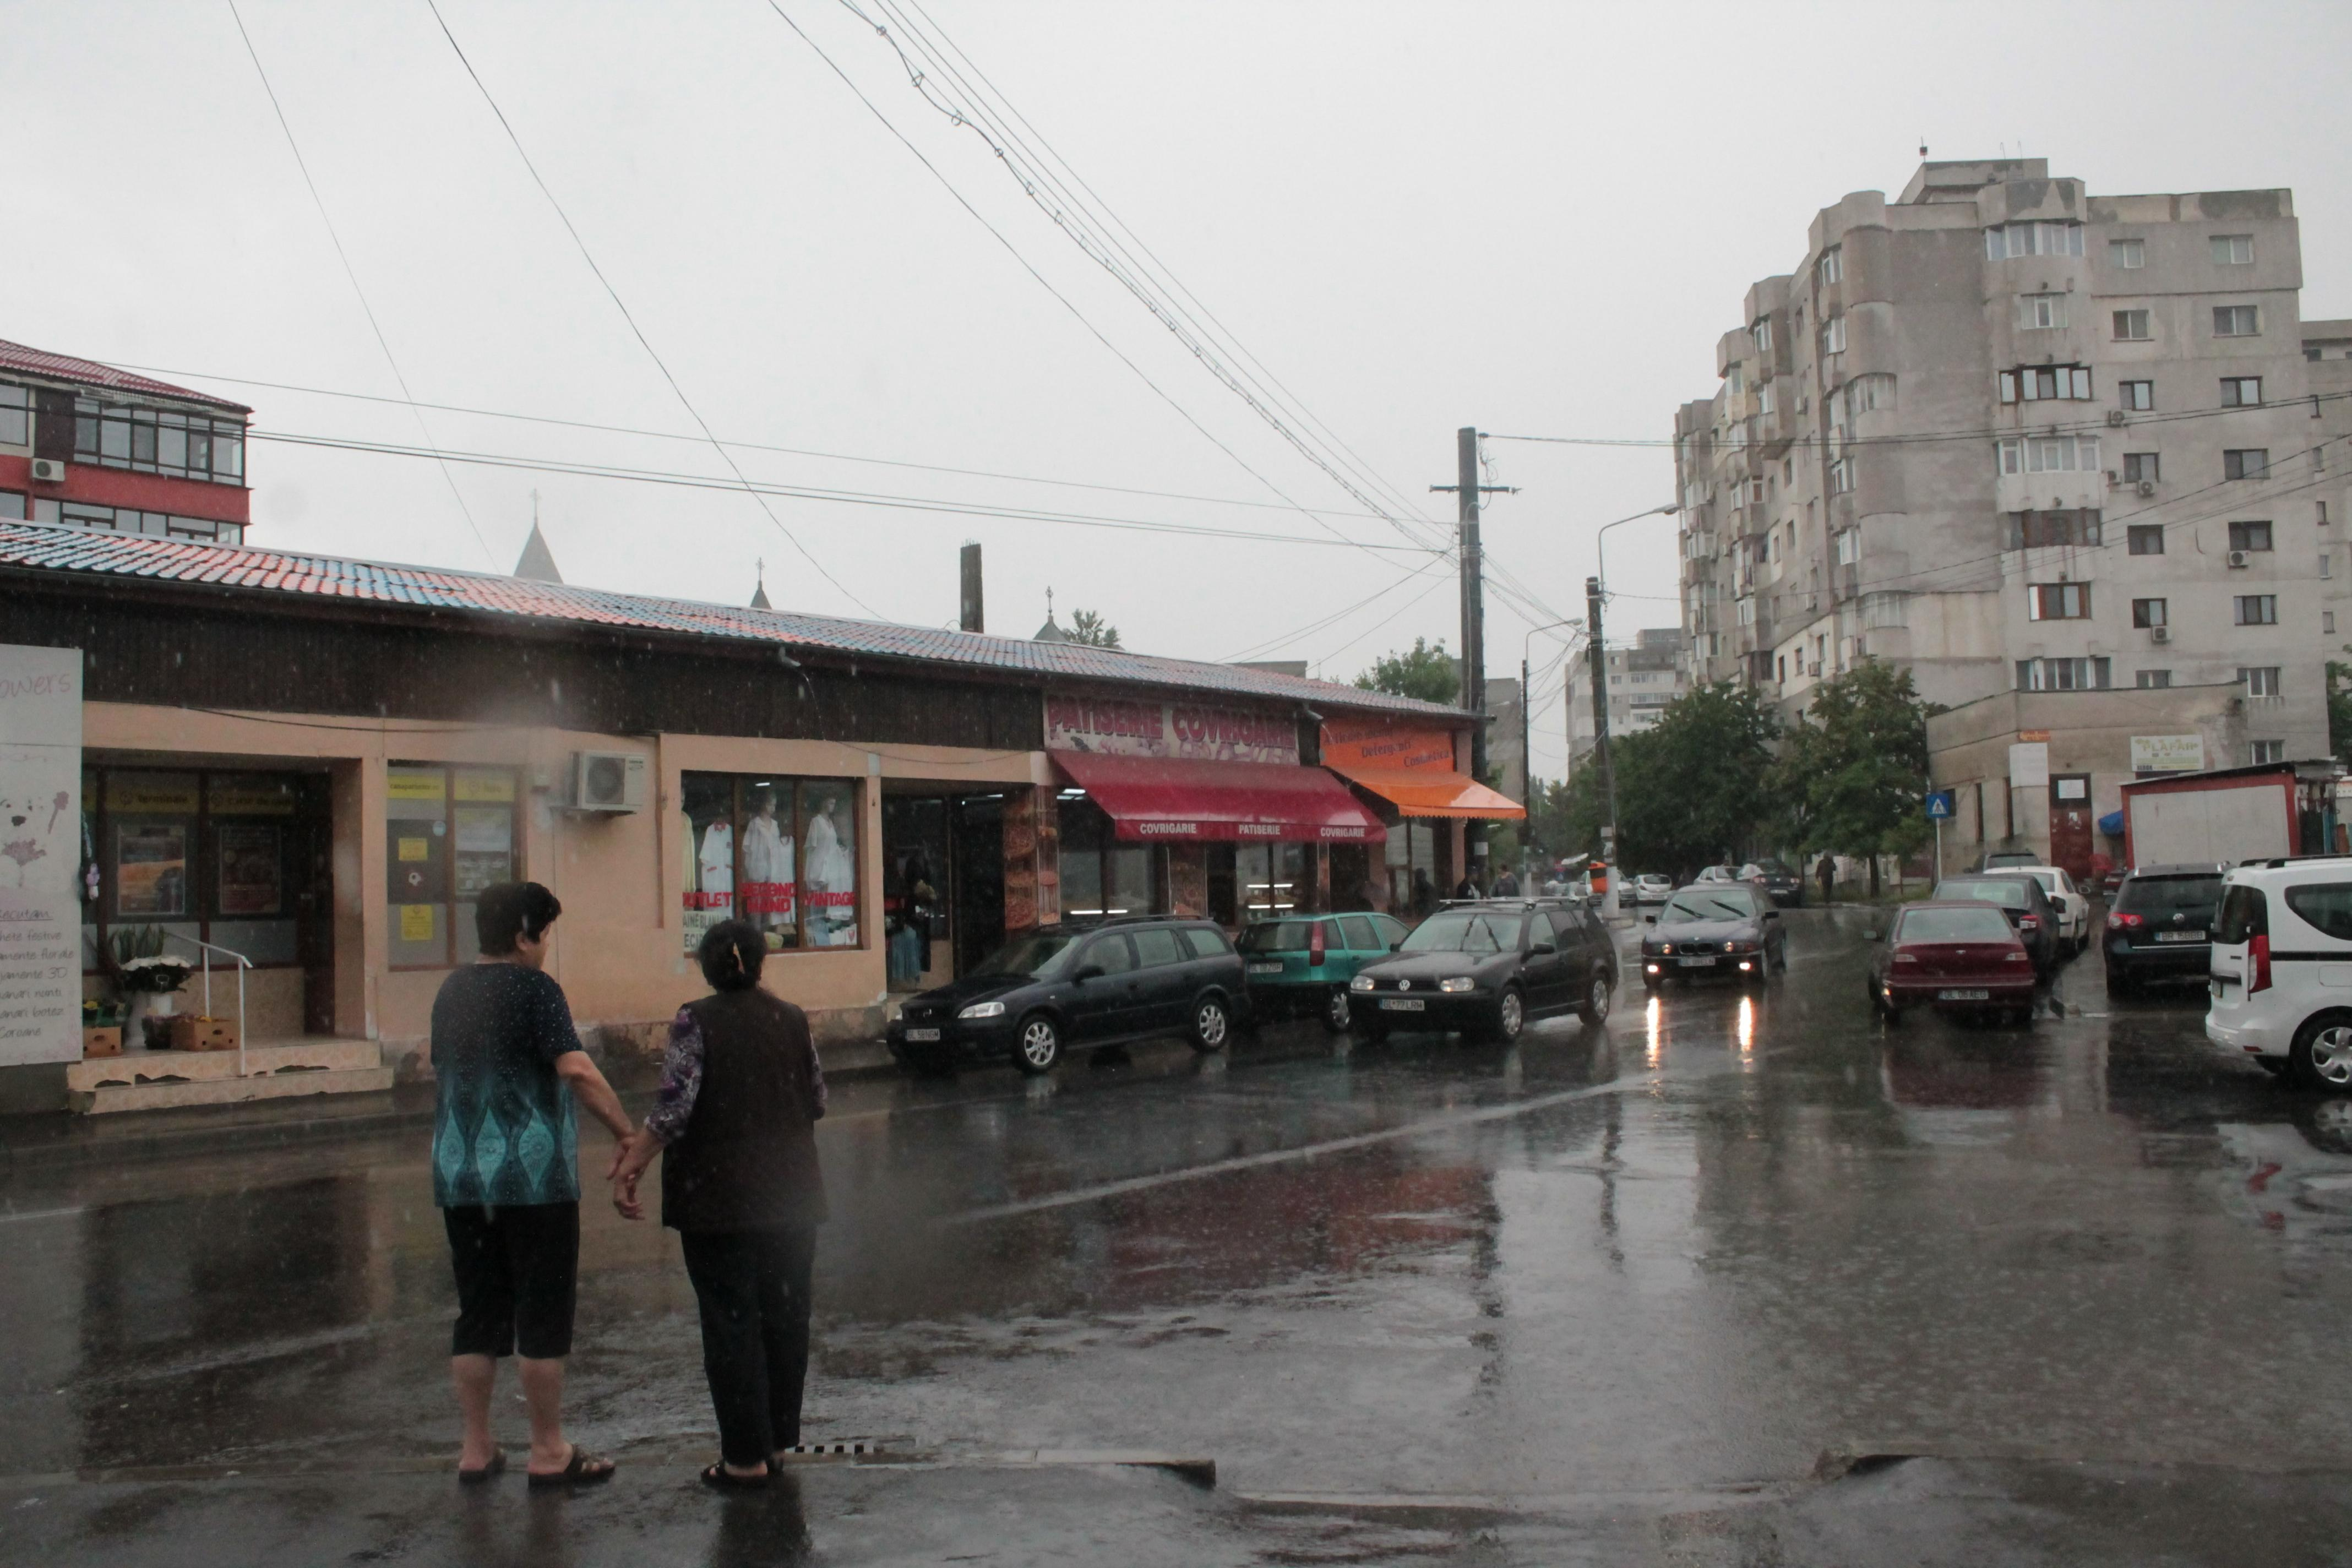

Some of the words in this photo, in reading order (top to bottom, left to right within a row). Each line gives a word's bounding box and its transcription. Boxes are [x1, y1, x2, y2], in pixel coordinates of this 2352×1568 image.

[1047, 696, 1163, 739] PATISERIE
[1172, 706, 1296, 749] COVRIGARIE
[1140, 823, 1197, 835] COVRIGARIE
[1238, 824, 1281, 836] PATISERIE
[1320, 827, 1365, 838] COVRIGARIE
[747, 898, 792, 913] HAND
[0, 909, 51, 920] ecutam
[48, 966, 68, 979] 3D
